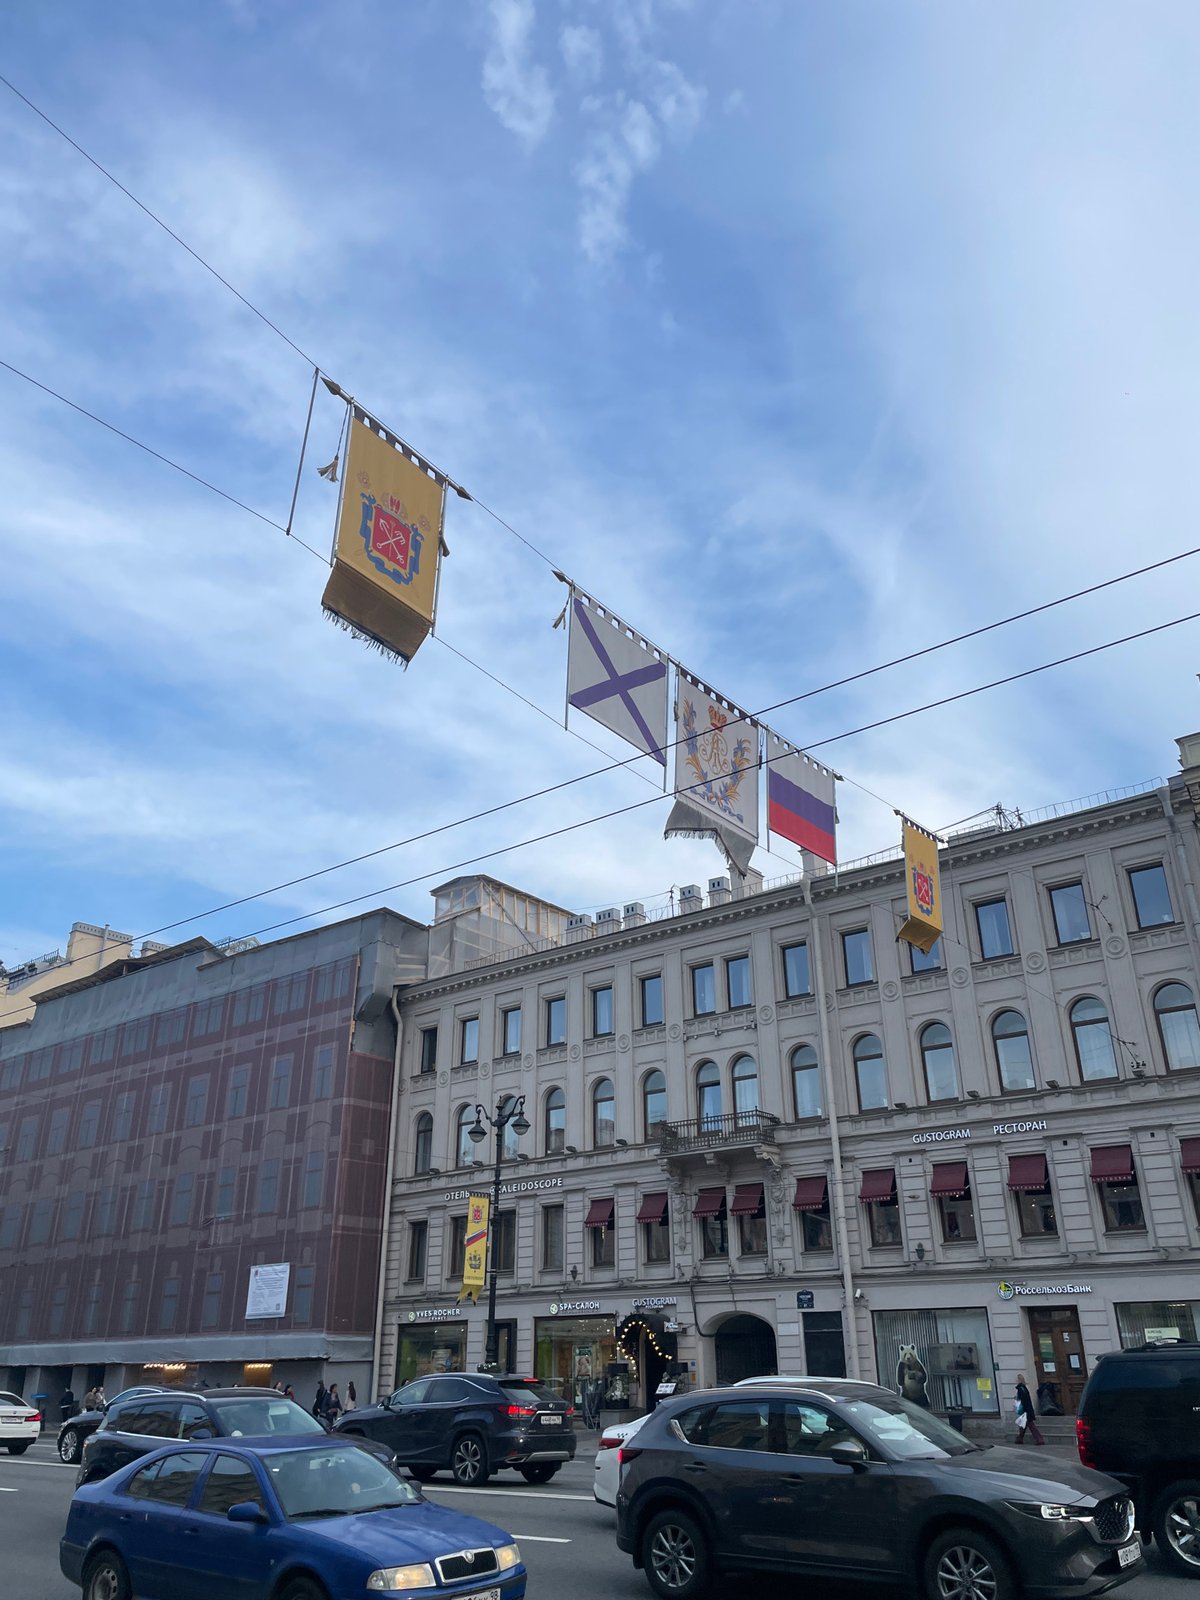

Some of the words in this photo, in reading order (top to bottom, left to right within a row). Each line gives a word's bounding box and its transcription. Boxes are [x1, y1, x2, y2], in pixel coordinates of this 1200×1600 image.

[993, 1121, 1047, 1135] РЕСТОРАН
[912, 1129, 971, 1143] GUSTOGRAM
[444, 1190, 470, 1201] ОТЕЛЬ
[559, 1301, 600, 1310] SPA-САЛОН
[632, 1297, 677, 1307] GUSTOGRAM
[416, 1310, 433, 1318] YVES
[433, 1308, 461, 1317] ROCHER
